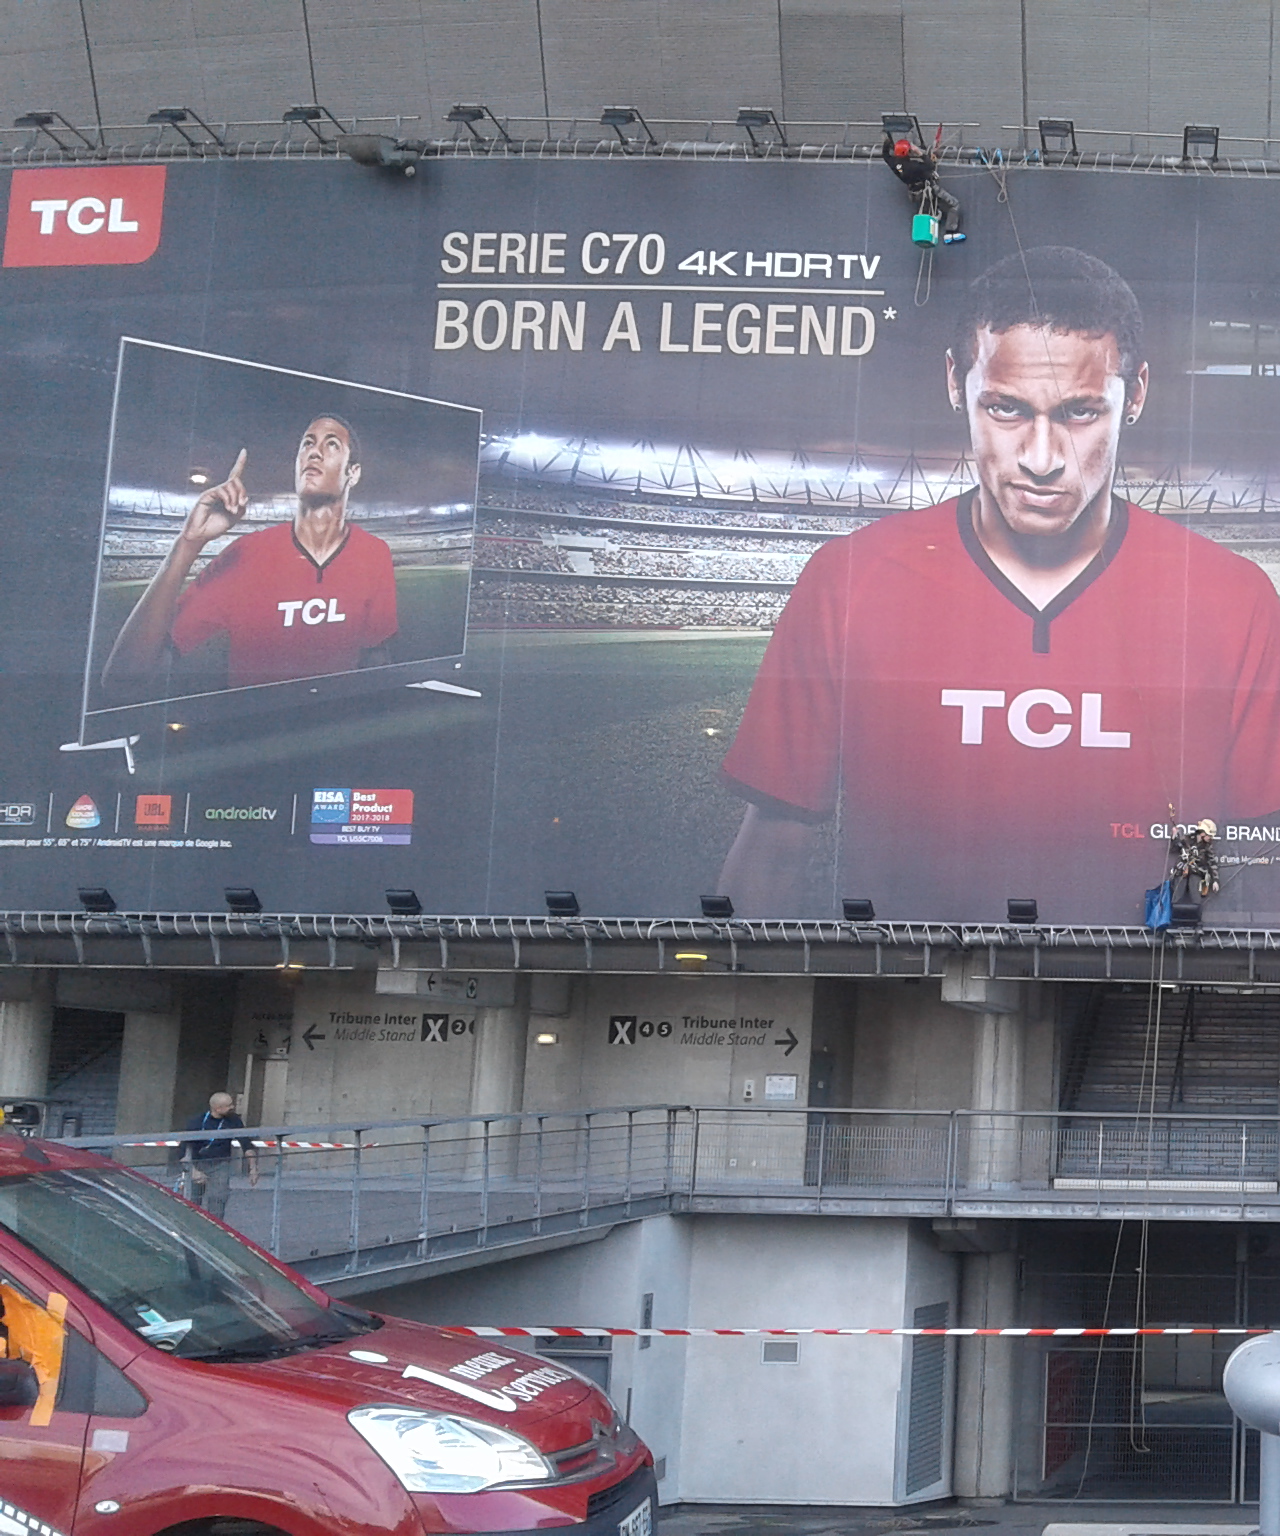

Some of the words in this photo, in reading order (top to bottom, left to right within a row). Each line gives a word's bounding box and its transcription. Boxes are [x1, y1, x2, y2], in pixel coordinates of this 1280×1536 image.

[30, 197, 139, 235] TCL
[440, 232, 567, 275] SERIE
[582, 232, 666, 276] C70
[678, 251, 737, 276] 4K
[434, 300, 586, 352] BORN
[602, 302, 642, 352] A
[278, 598, 346, 627] TCL
[941, 688, 1131, 749] TCL
[314, 791, 345, 803] EISA
[353, 792, 376, 801] Best
[352, 803, 393, 813] Product
[351, 814, 390, 822] 2017-2018
[1110, 822, 1146, 839] TCL
[329, 1012, 381, 1026] Tribune
[384, 1012, 418, 1026] Inter
[682, 1016, 737, 1029] Tribune
[740, 1016, 775, 1029] Inter
[334, 1028, 376, 1042] Middle
[378, 1028, 416, 1042] Stand
[424, 1018, 445, 1042] X
[612, 1020, 632, 1045] X
[680, 1033, 725, 1046] Middle
[728, 1033, 766, 1046] Stand
[500, 1366, 573, 1402] services
